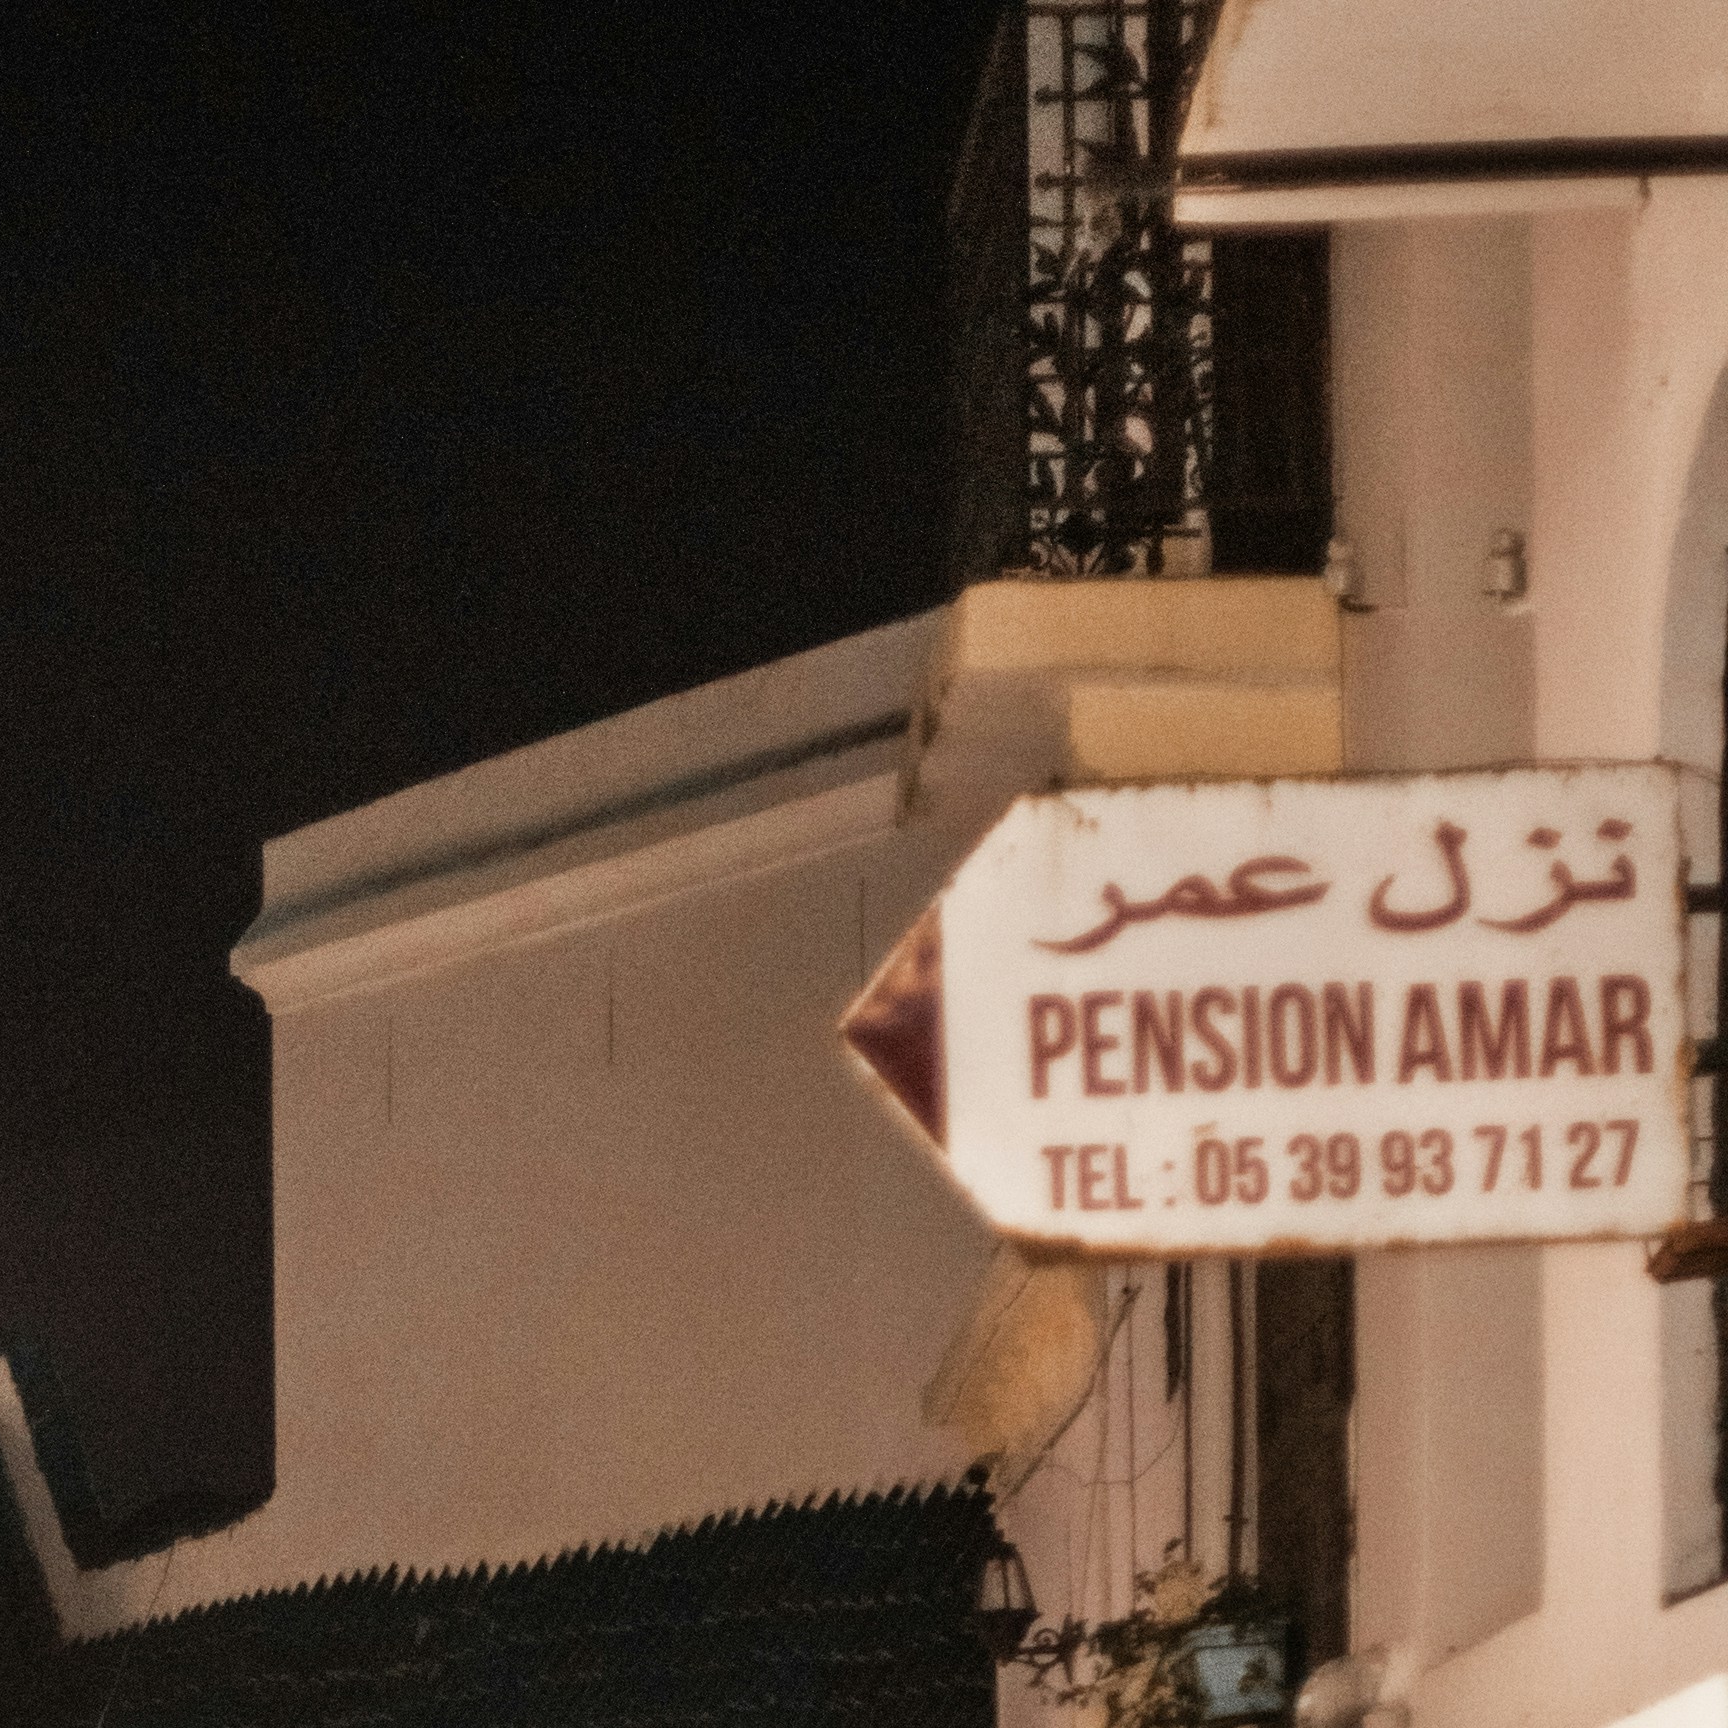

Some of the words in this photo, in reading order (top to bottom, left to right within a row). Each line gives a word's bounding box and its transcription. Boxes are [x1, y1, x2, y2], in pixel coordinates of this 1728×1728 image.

[1031, 854, 1332, 955] عمر
[1366, 816, 1638, 934] نزل
[1028, 979, 1376, 1101] PENSION
[1396, 973, 1656, 1088] AMAR
[1193, 1134, 1269, 1206] 05
[1287, 1130, 1362, 1202] 39
[1380, 1127, 1456, 1198] 93
[1475, 1122, 1543, 1192] 71
[1566, 1118, 1642, 1190] 27
